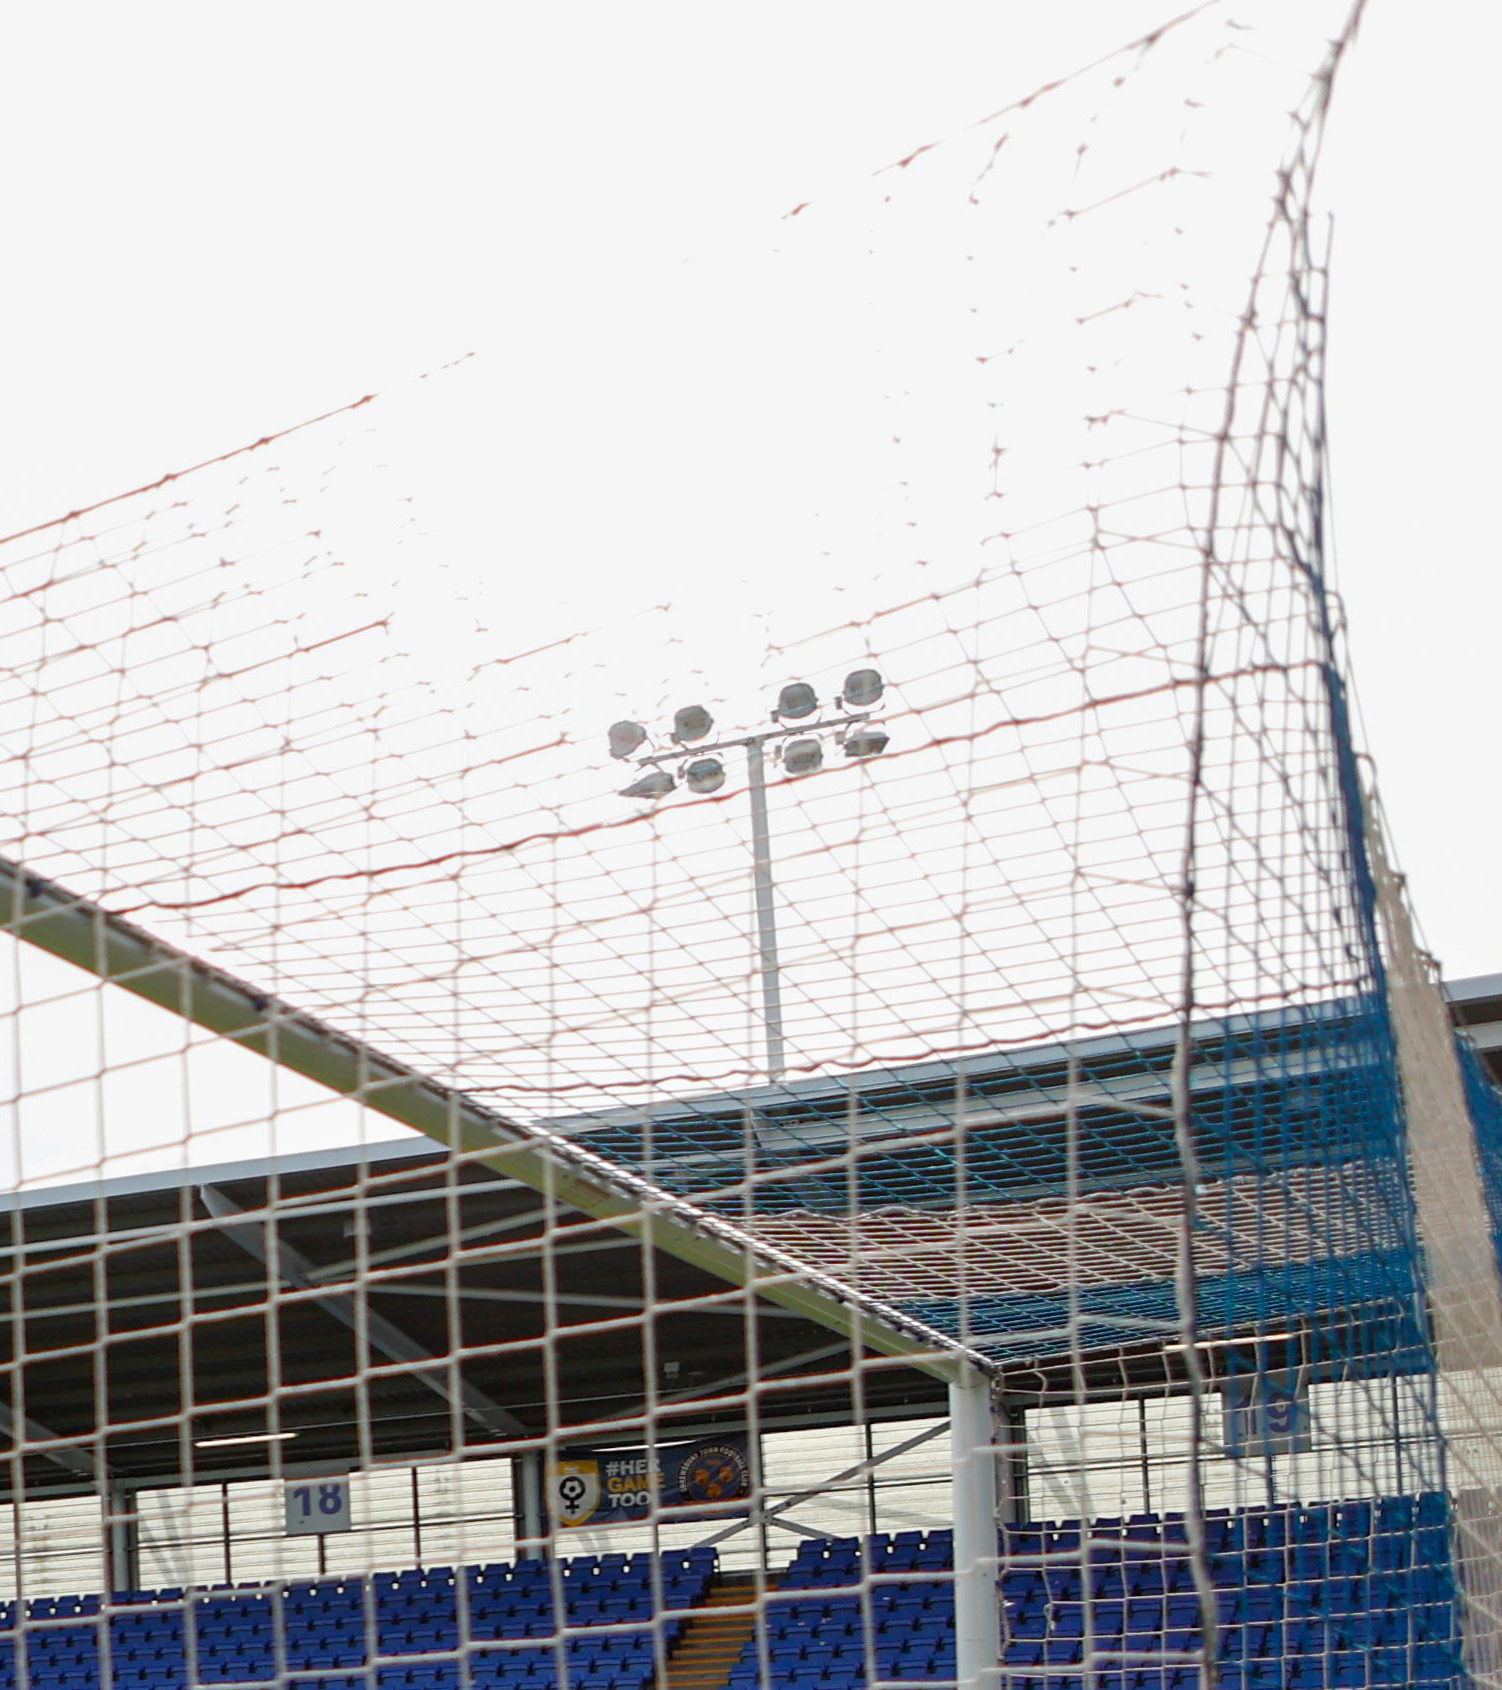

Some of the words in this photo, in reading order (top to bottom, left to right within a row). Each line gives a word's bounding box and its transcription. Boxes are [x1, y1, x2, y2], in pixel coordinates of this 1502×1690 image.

[1236, 1392, 1295, 1433] 19
[605, 1457, 661, 1476] #HER
[607, 1473, 666, 1493] GAME
[294, 1484, 342, 1517] 18
[608, 1492, 652, 1508] TOO
